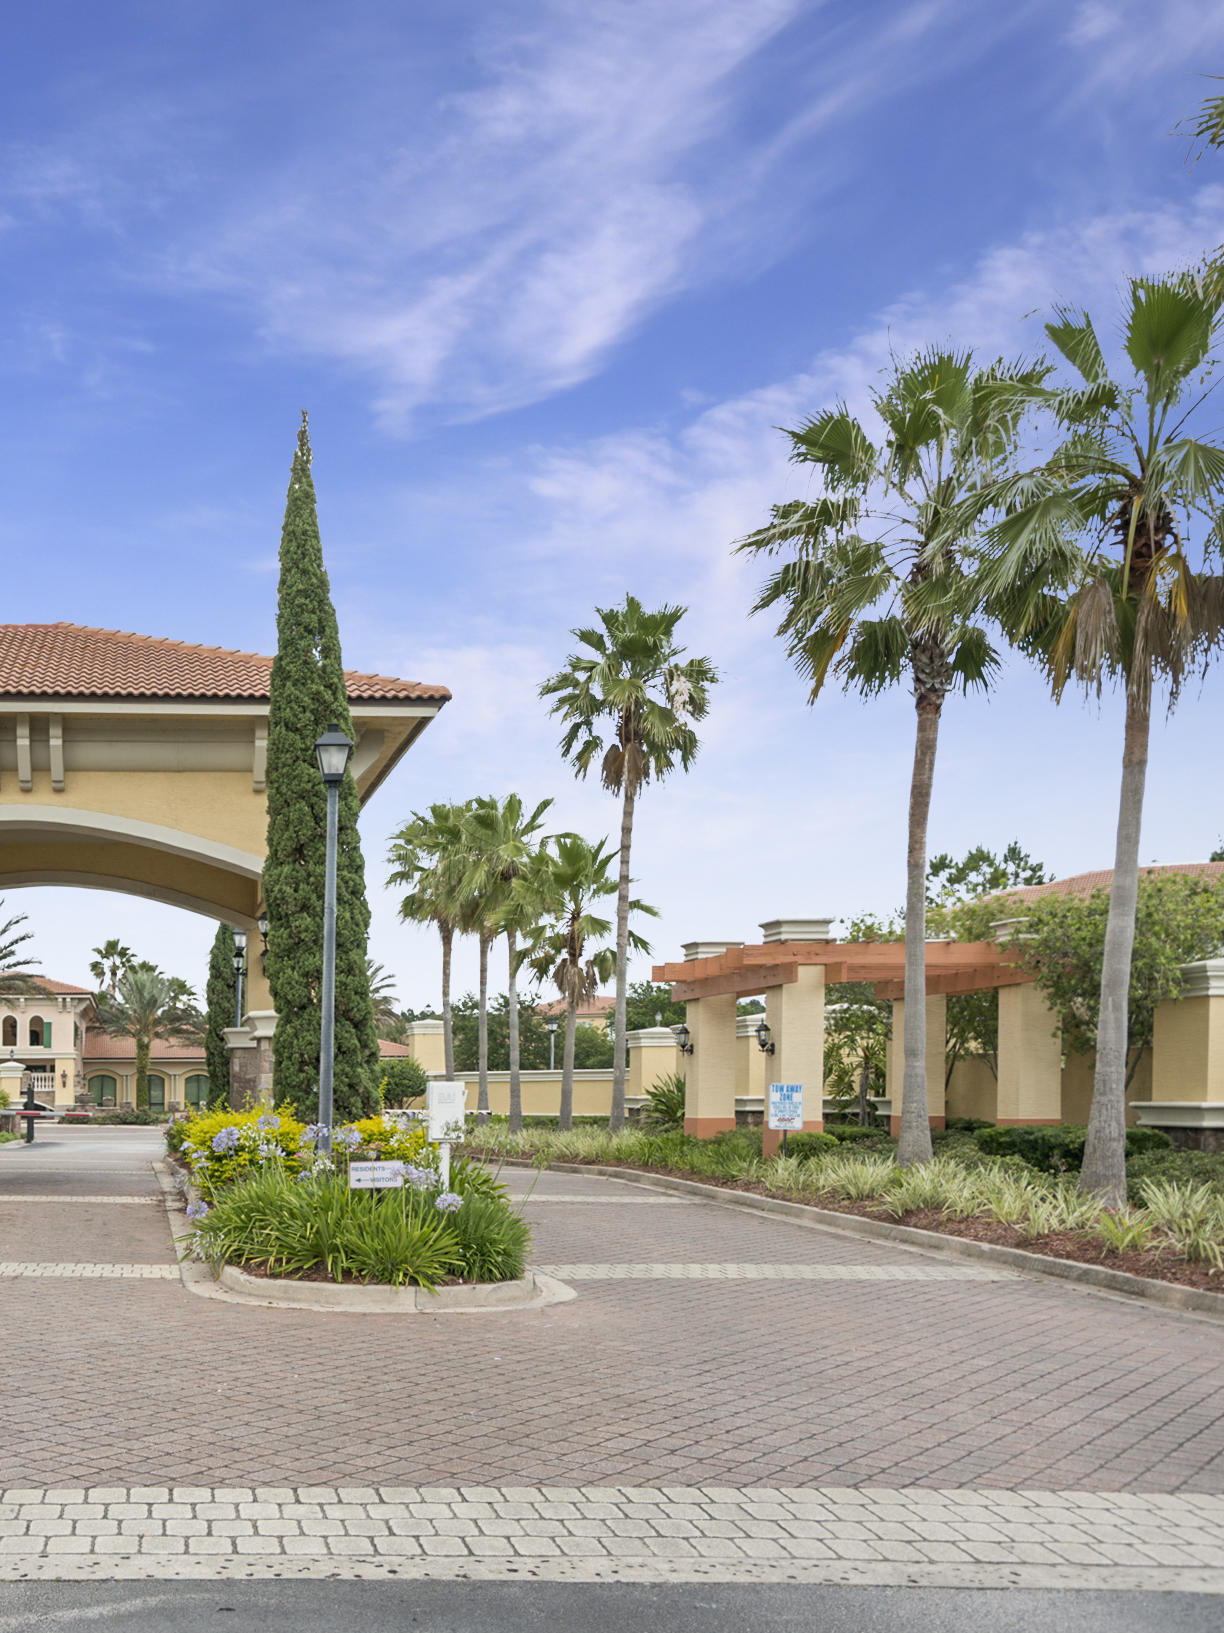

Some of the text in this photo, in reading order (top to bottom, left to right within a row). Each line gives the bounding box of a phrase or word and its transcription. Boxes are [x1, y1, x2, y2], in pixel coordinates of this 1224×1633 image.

[771, 1084, 802, 1092] TOW AWAY
[779, 1093, 793, 1101] ZONE
